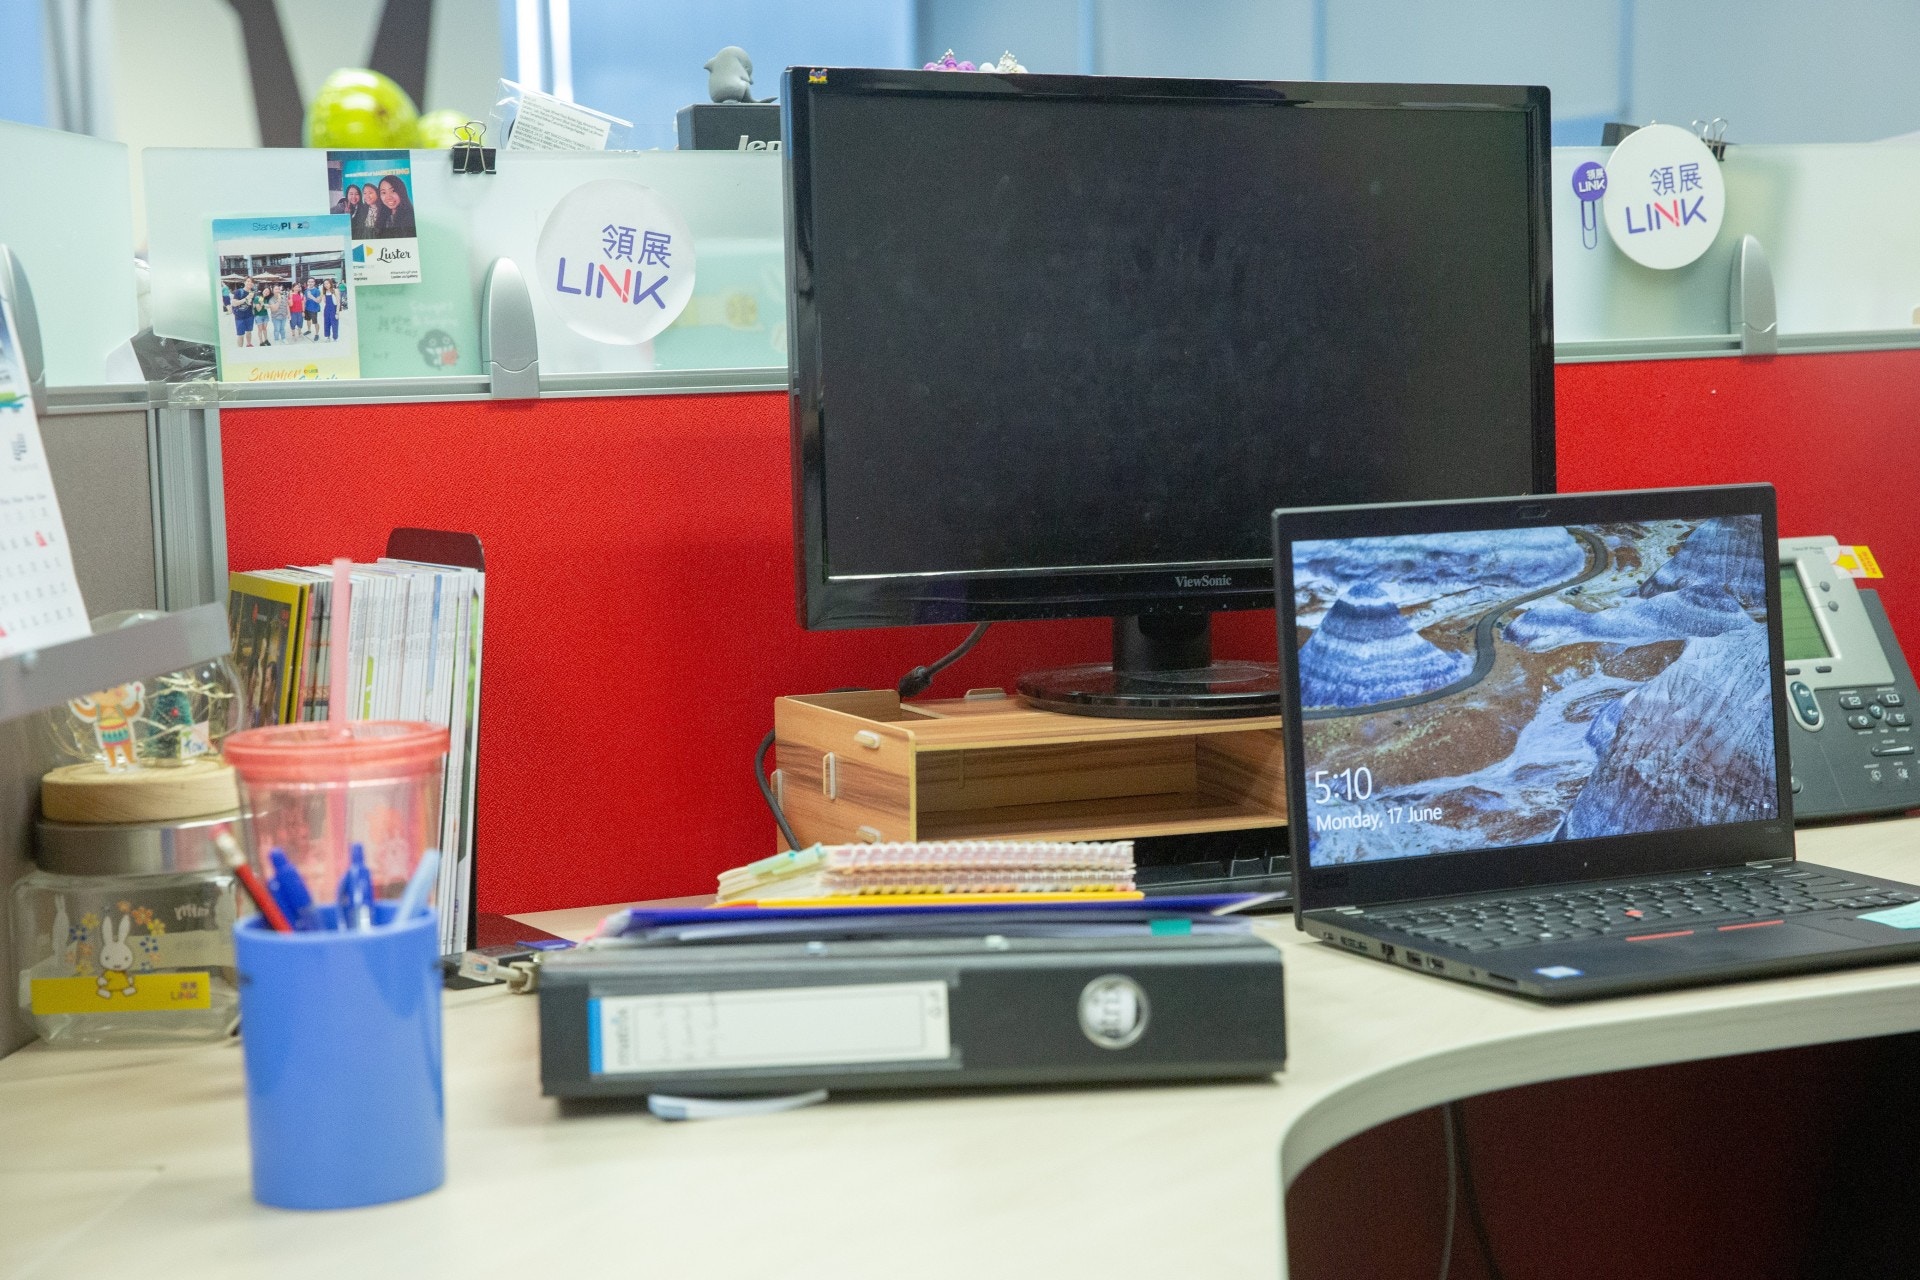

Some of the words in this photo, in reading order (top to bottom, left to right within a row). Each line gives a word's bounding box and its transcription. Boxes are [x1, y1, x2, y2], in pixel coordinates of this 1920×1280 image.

[1578, 179, 1605, 192] LINK
[1650, 163, 1703, 196] 領展
[1625, 196, 1707, 234] LINK
[377, 247, 411, 263] Luster
[602, 224, 671, 268] 領展
[556, 257, 669, 309] LINK
[249, 367, 302, 381] Summer
[1175, 574, 1232, 587] ViewSonic
[1315, 767, 1372, 804] 5:10
[1316, 808, 1383, 832] Monday,
[1387, 807, 1403, 824] 17
[1407, 806, 1442, 823] June
